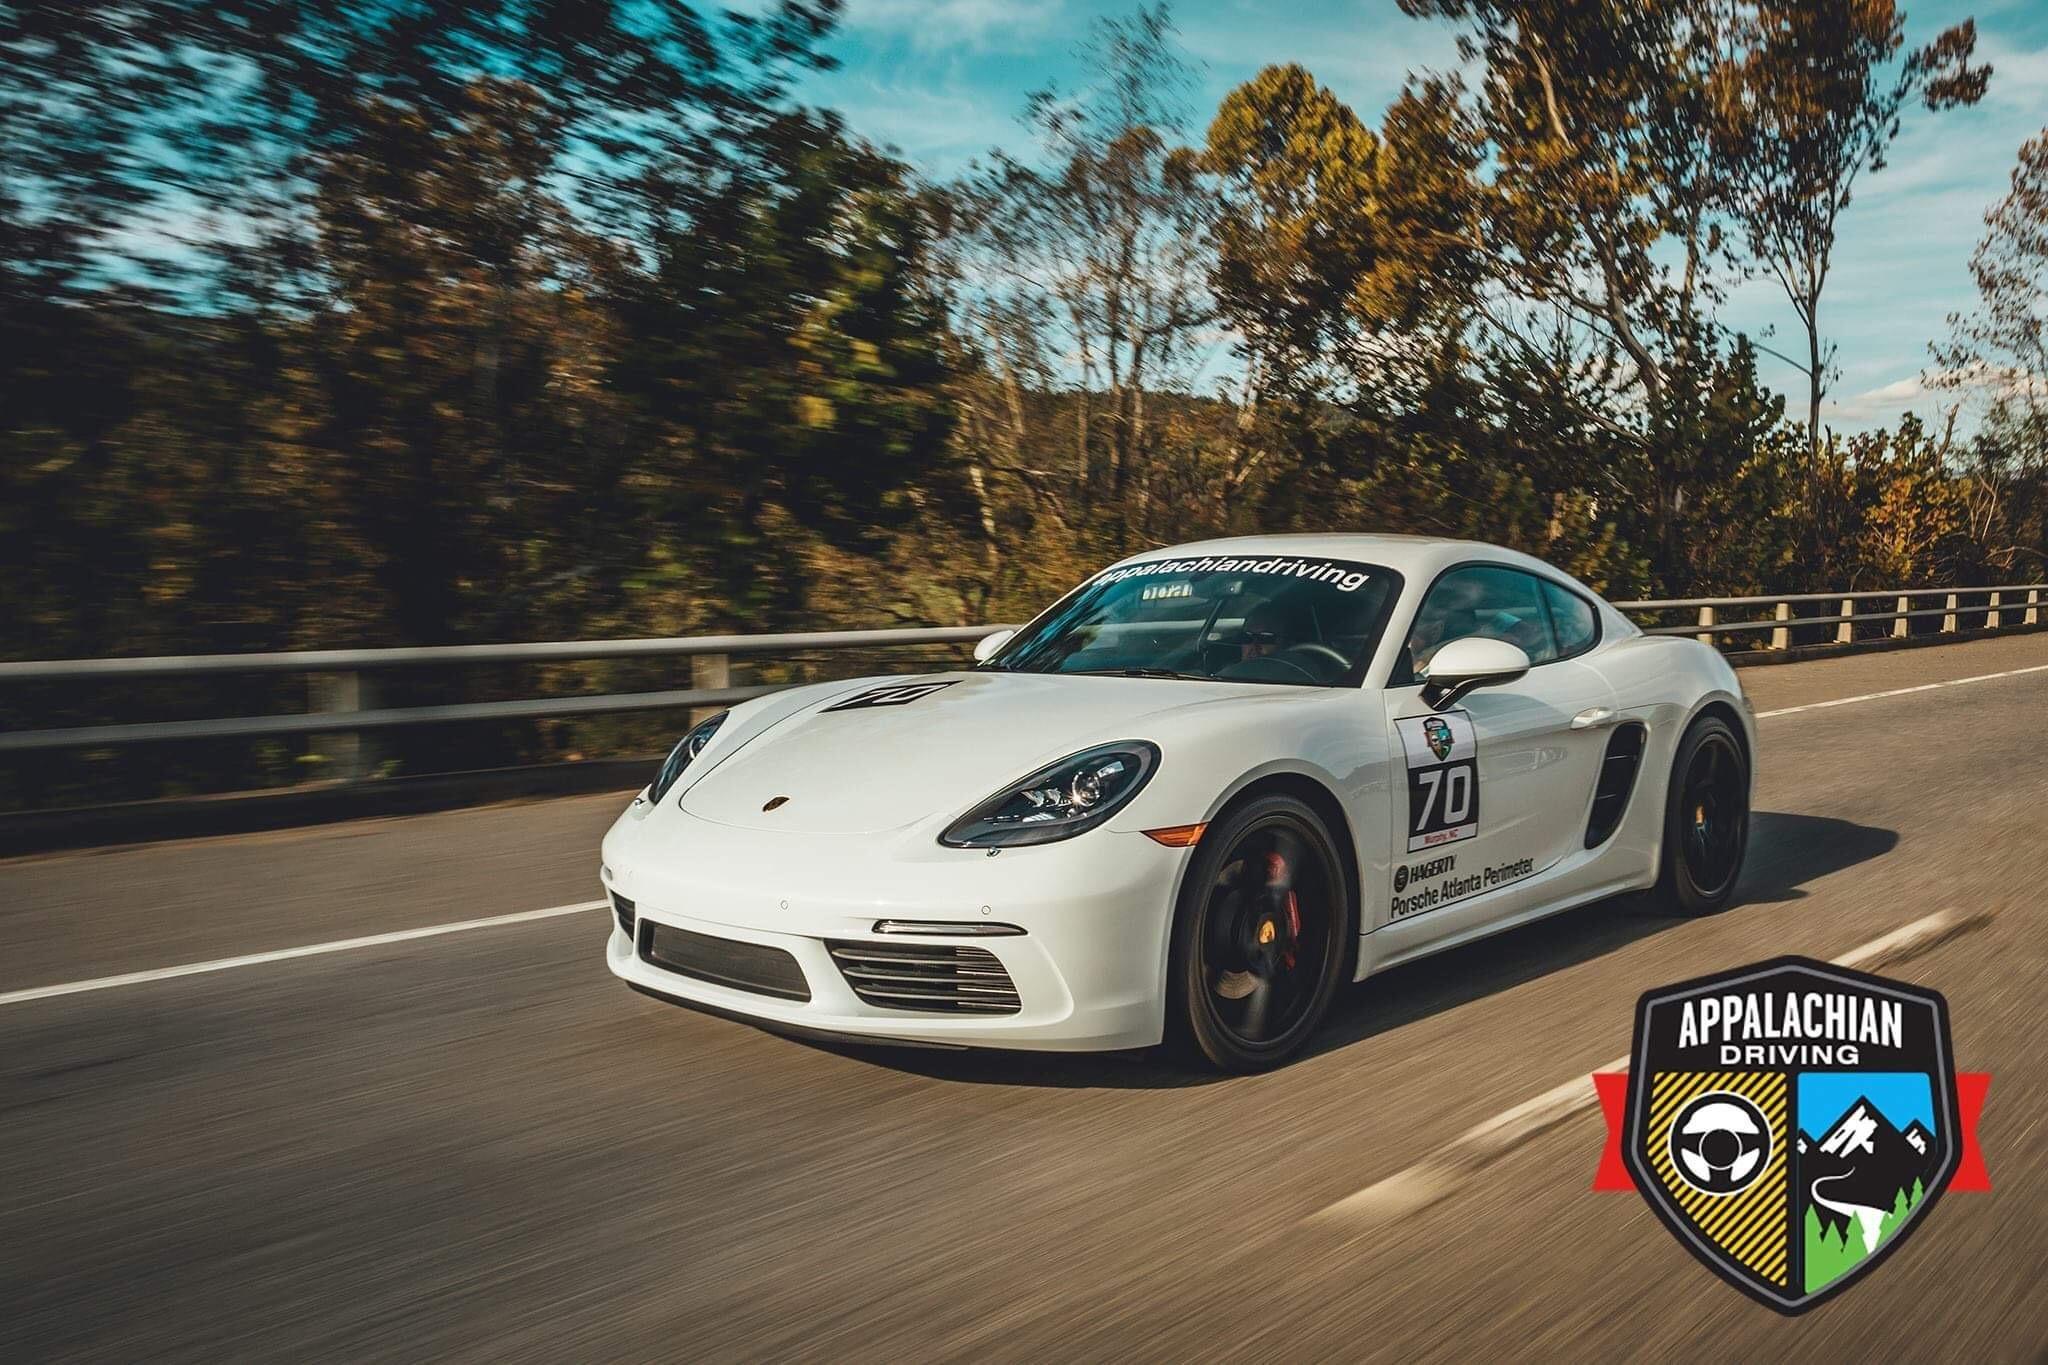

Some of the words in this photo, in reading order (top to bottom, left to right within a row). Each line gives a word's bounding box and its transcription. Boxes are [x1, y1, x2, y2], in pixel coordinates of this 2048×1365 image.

[1416, 765, 1472, 831] 70
[1390, 886, 1439, 919] Porsche
[1440, 874, 1482, 902] Atlanta
[1483, 858, 1534, 887] Perimeter
[1409, 855, 1458, 884] HAGERTY
